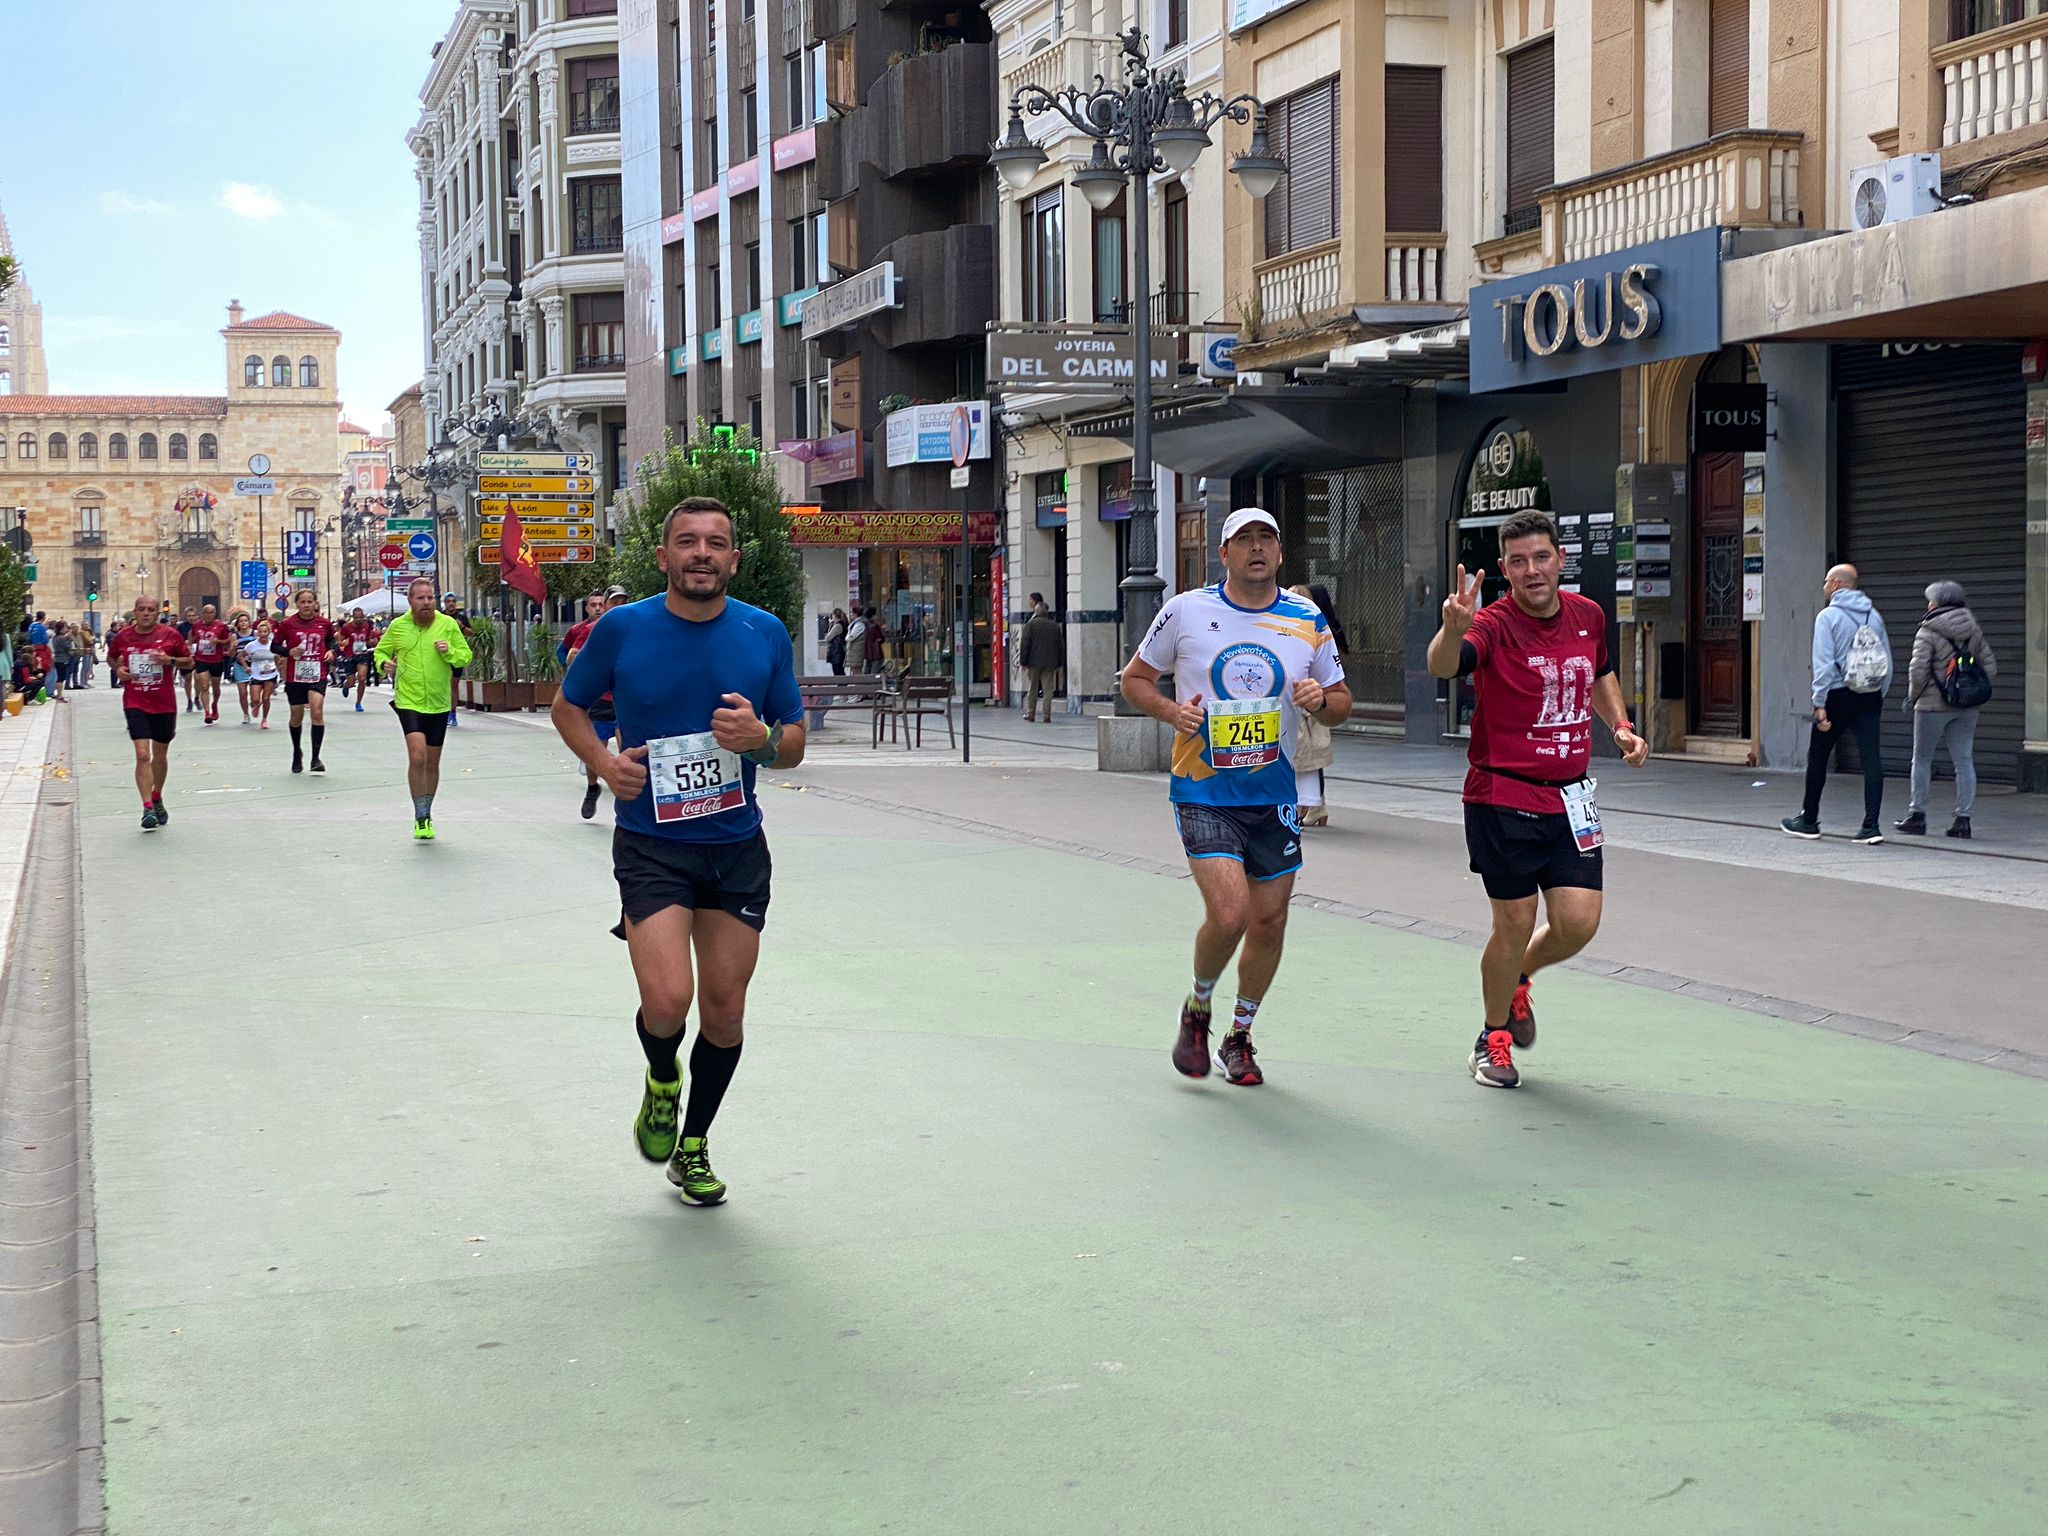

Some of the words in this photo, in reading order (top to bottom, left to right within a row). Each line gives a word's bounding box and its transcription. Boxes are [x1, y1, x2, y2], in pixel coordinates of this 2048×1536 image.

[1492, 264, 1662, 361] TOUS
[1054, 341, 1115, 352] JOYERIA
[1002, 357, 1048, 376] DEL
[1063, 357, 1167, 378] CARMN
[1702, 410, 1761, 426] TOUS
[567, 456, 575, 466] P
[1494, 443, 1509, 464] BE
[237, 480, 272, 491] Cámara
[482, 504, 499, 512] Luis
[517, 504, 537, 512] León
[1471, 493, 1488, 512] BE
[1490, 486, 1538, 511] BEAUTY
[792, 514, 854, 526] OYAL
[290, 532, 304, 554] P
[1229, 720, 1265, 746] 245
[674, 758, 722, 792] 533
